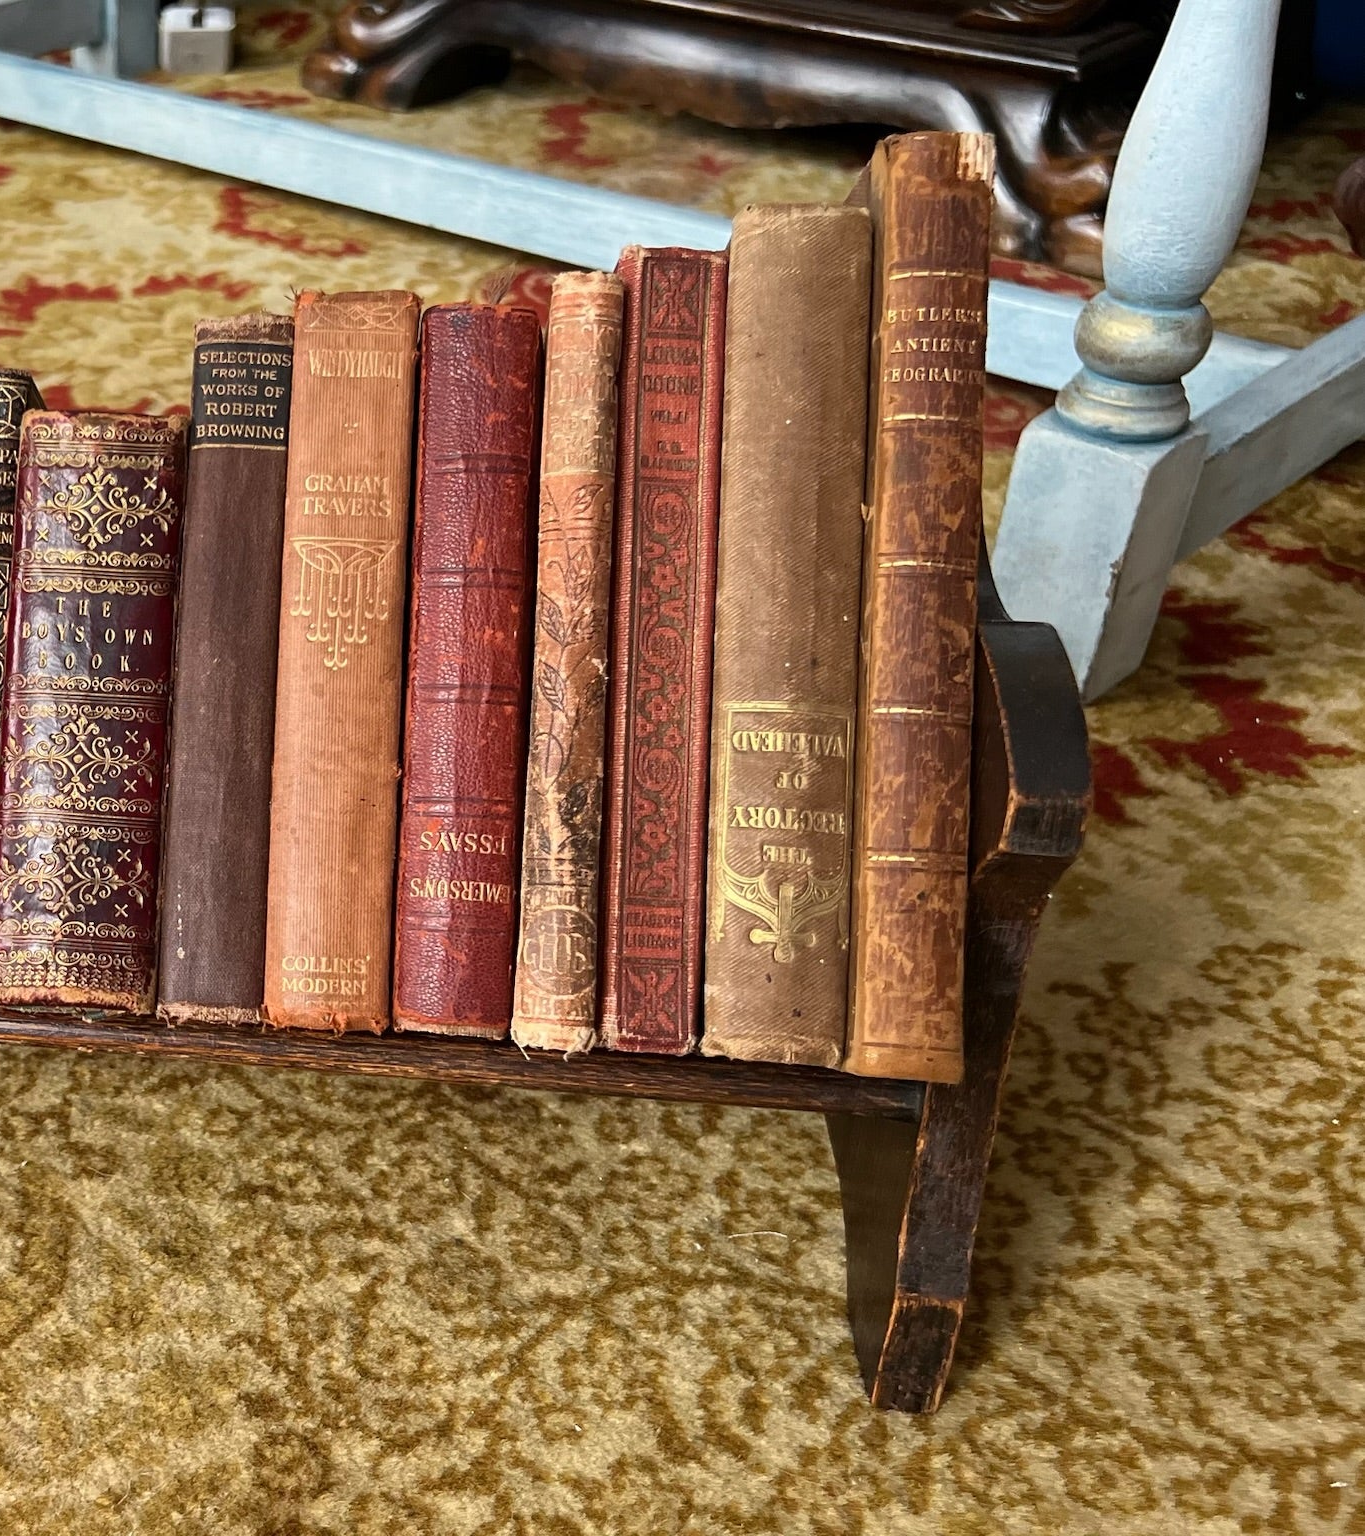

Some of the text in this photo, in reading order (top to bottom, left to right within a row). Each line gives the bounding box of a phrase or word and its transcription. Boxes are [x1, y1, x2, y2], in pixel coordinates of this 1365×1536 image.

[198, 350, 292, 368] SELECTIONS
[211, 368, 278, 381] FROM THE
[200, 384, 285, 398] WORKS OF
[204, 402, 277, 418] ROBERT
[195, 423, 285, 440] BROWNING
[304, 474, 388, 495] GRAHAM
[302, 496, 392, 518] TRAVERS
[56, 596, 112, 618] THE
[22, 621, 153, 645] BOY'S OWN
[775, 771, 809, 790] OF
[730, 806, 845, 835] RECTORY
[419, 831, 507, 856] ESSAYS
[281, 977, 366, 996] MODERN
